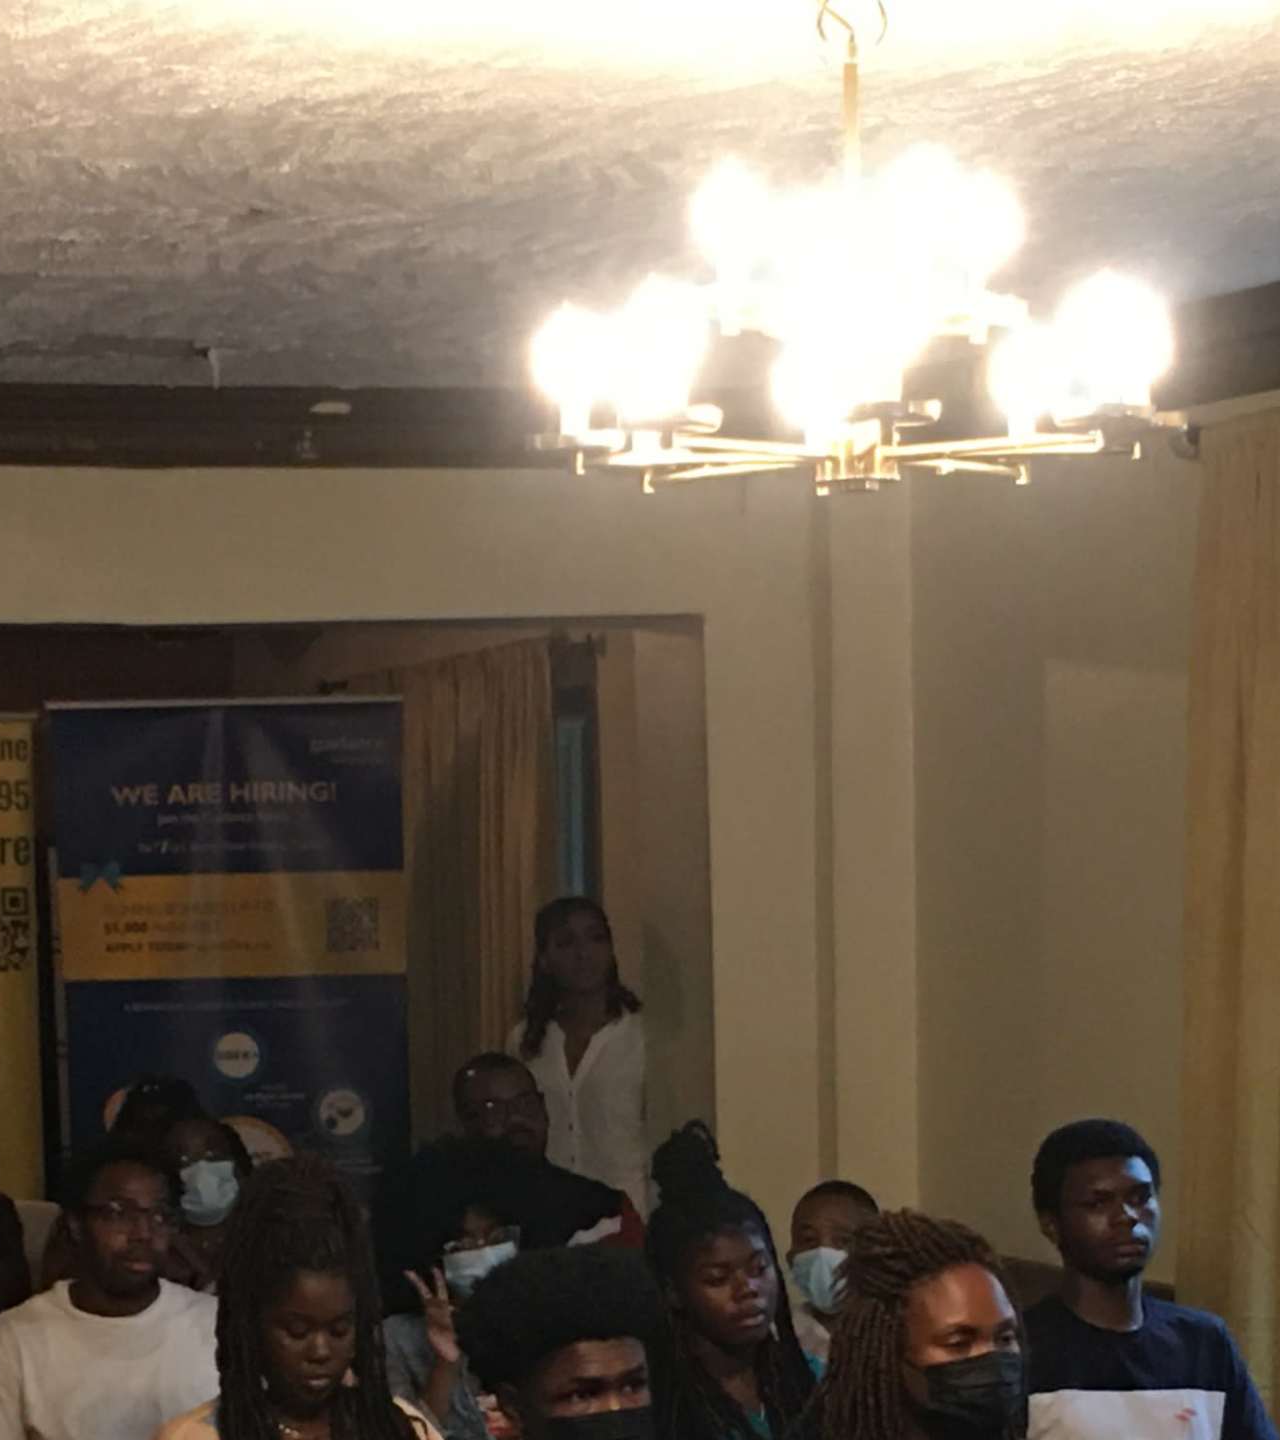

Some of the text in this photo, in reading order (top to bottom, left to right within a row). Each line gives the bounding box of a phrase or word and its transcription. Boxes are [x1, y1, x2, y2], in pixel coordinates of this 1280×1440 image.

[111, 780, 338, 807] WE ARE HIRING!
